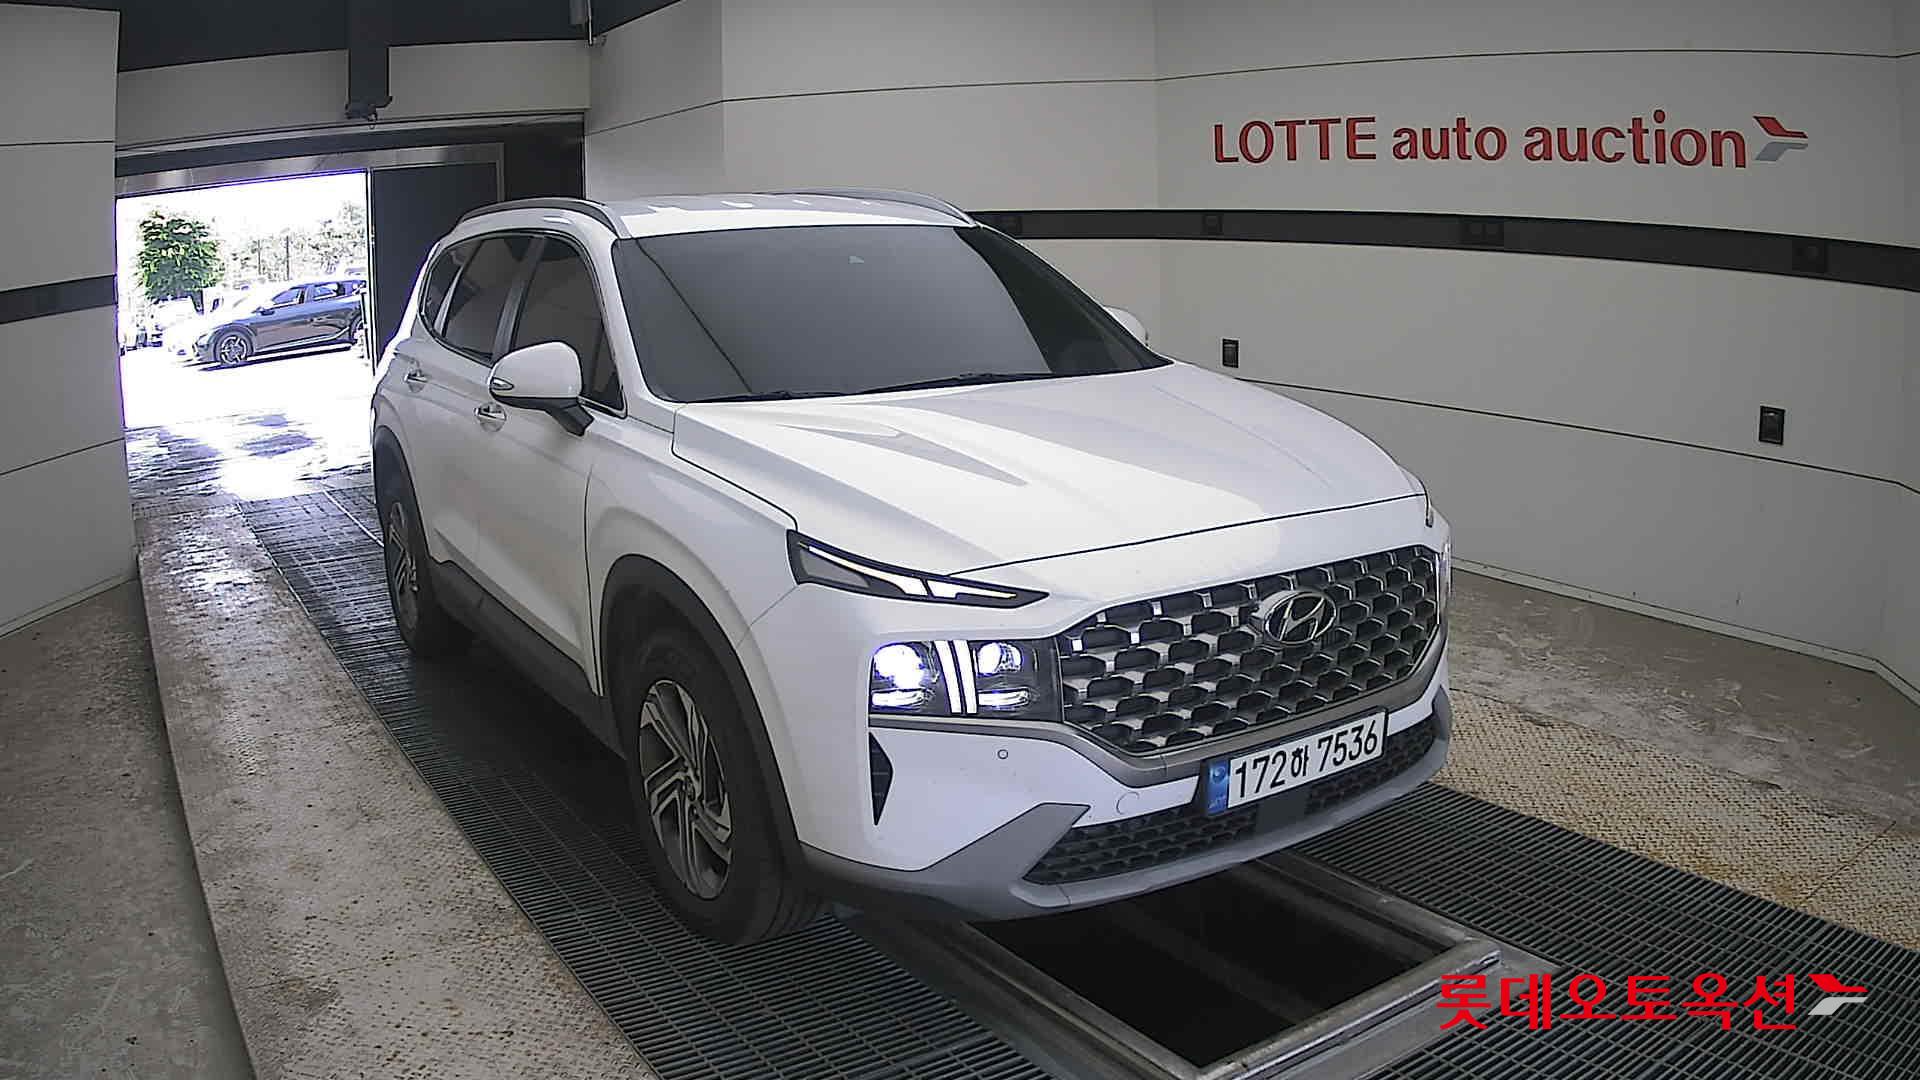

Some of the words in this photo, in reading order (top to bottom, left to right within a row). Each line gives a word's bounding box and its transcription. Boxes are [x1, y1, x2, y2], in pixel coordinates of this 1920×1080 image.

[1213, 116, 1377, 164] LOTTE
[1392, 116, 1509, 162] auto
[1523, 108, 1747, 169] auction
[1235, 744, 1309, 798] 172하
[1317, 719, 1378, 773] 7536
